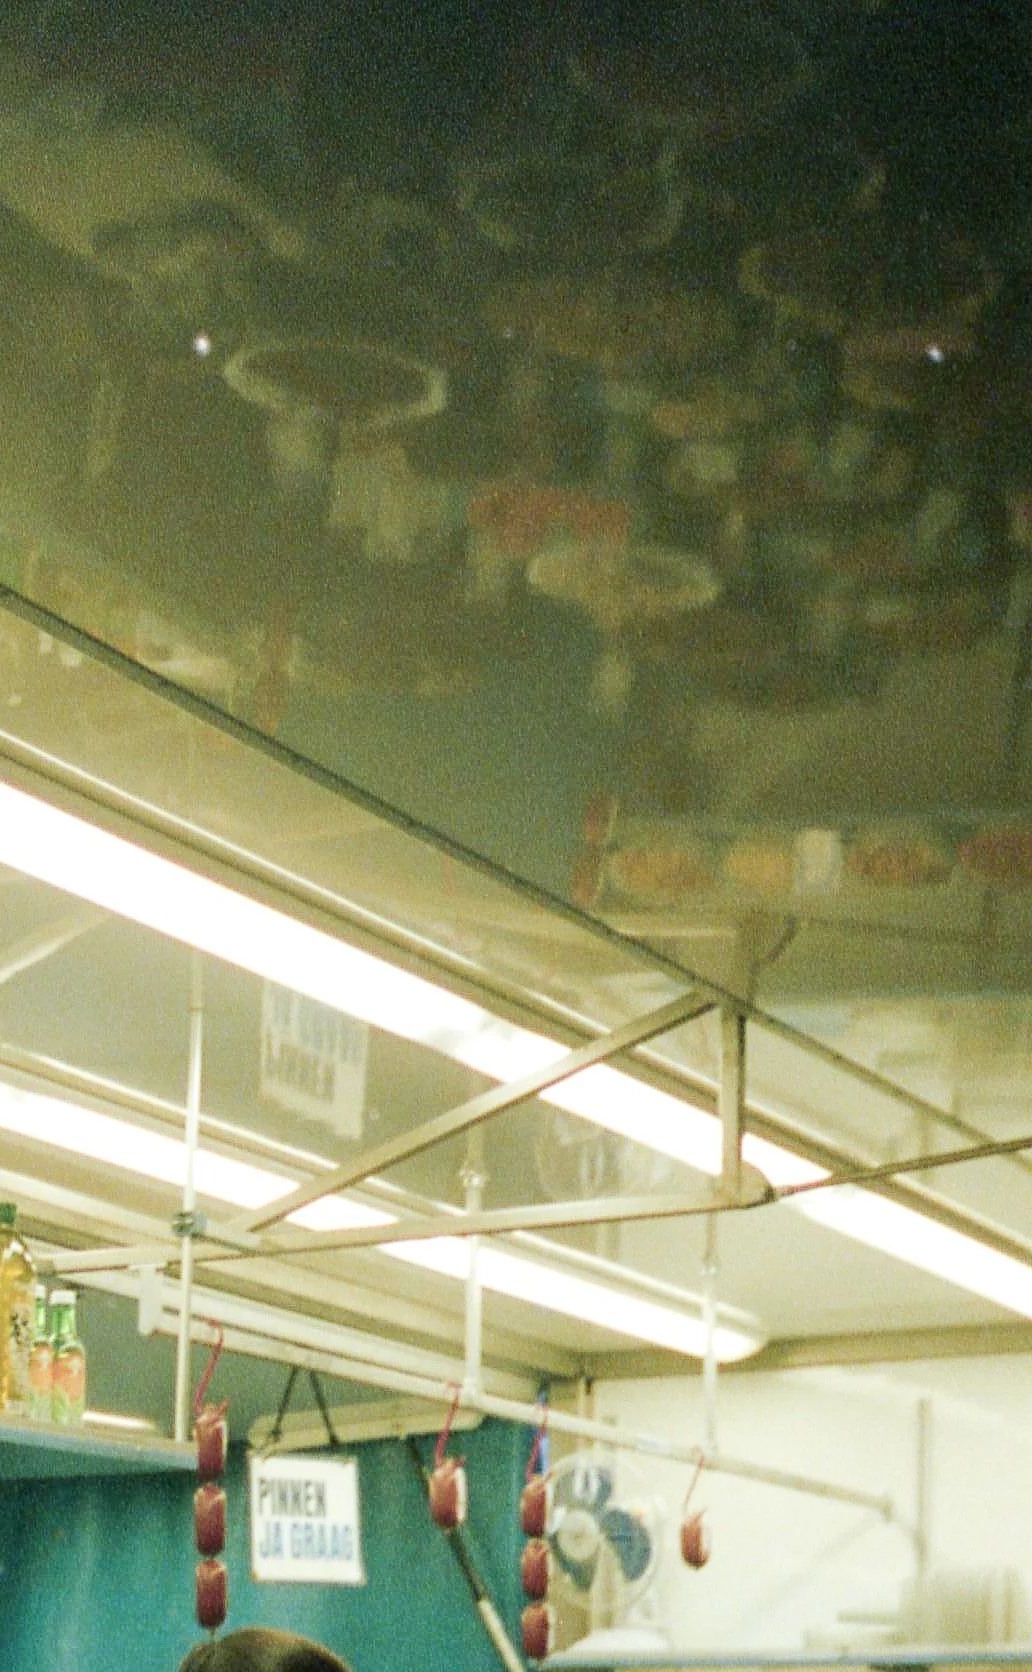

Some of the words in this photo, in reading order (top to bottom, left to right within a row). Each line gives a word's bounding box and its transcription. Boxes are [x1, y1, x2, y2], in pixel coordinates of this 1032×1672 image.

[258, 1476, 326, 1517] PINNEN
[259, 1521, 285, 1560] JA
[290, 1522, 354, 1561] GRAAG
